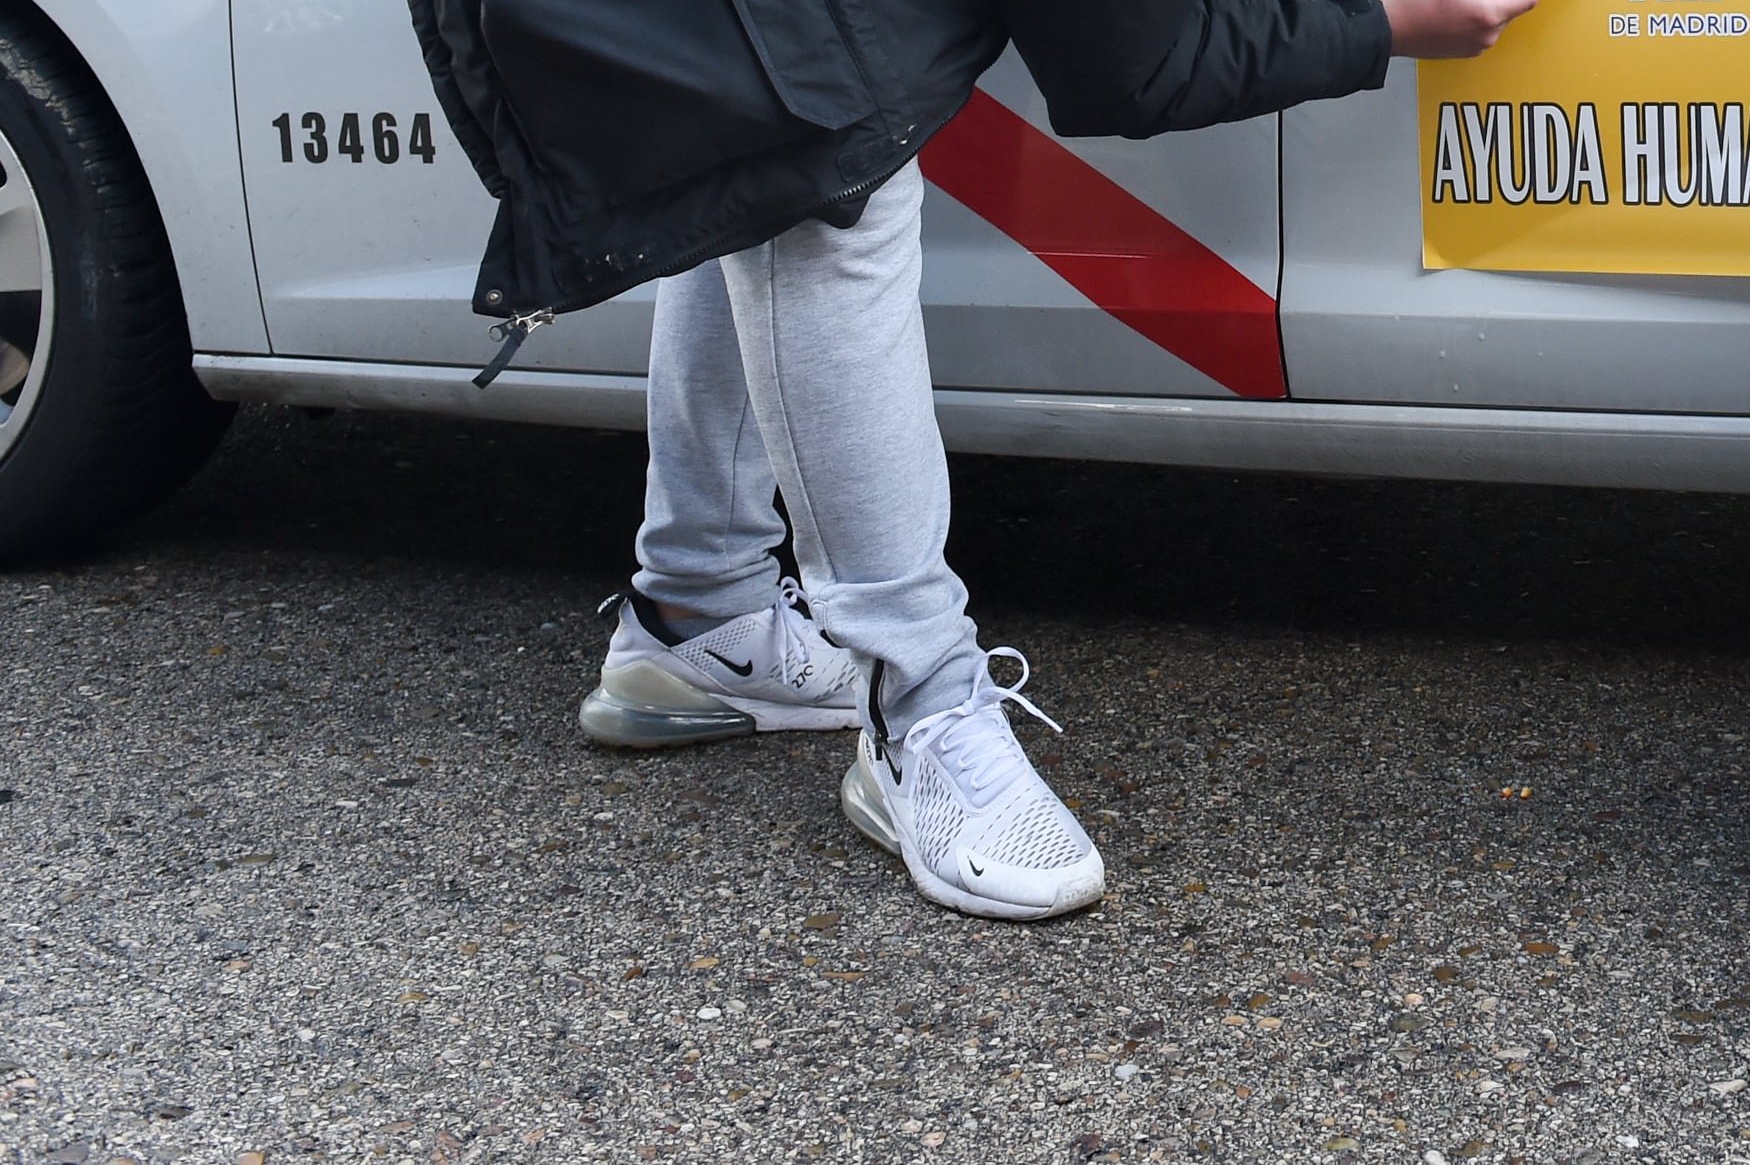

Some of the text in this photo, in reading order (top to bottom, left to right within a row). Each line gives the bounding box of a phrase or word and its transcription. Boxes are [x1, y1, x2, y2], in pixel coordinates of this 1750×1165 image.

[1610, 13, 1749, 37] DE MADRID
[272, 112, 435, 164] 13464
[1431, 102, 1608, 206] AYUDA
